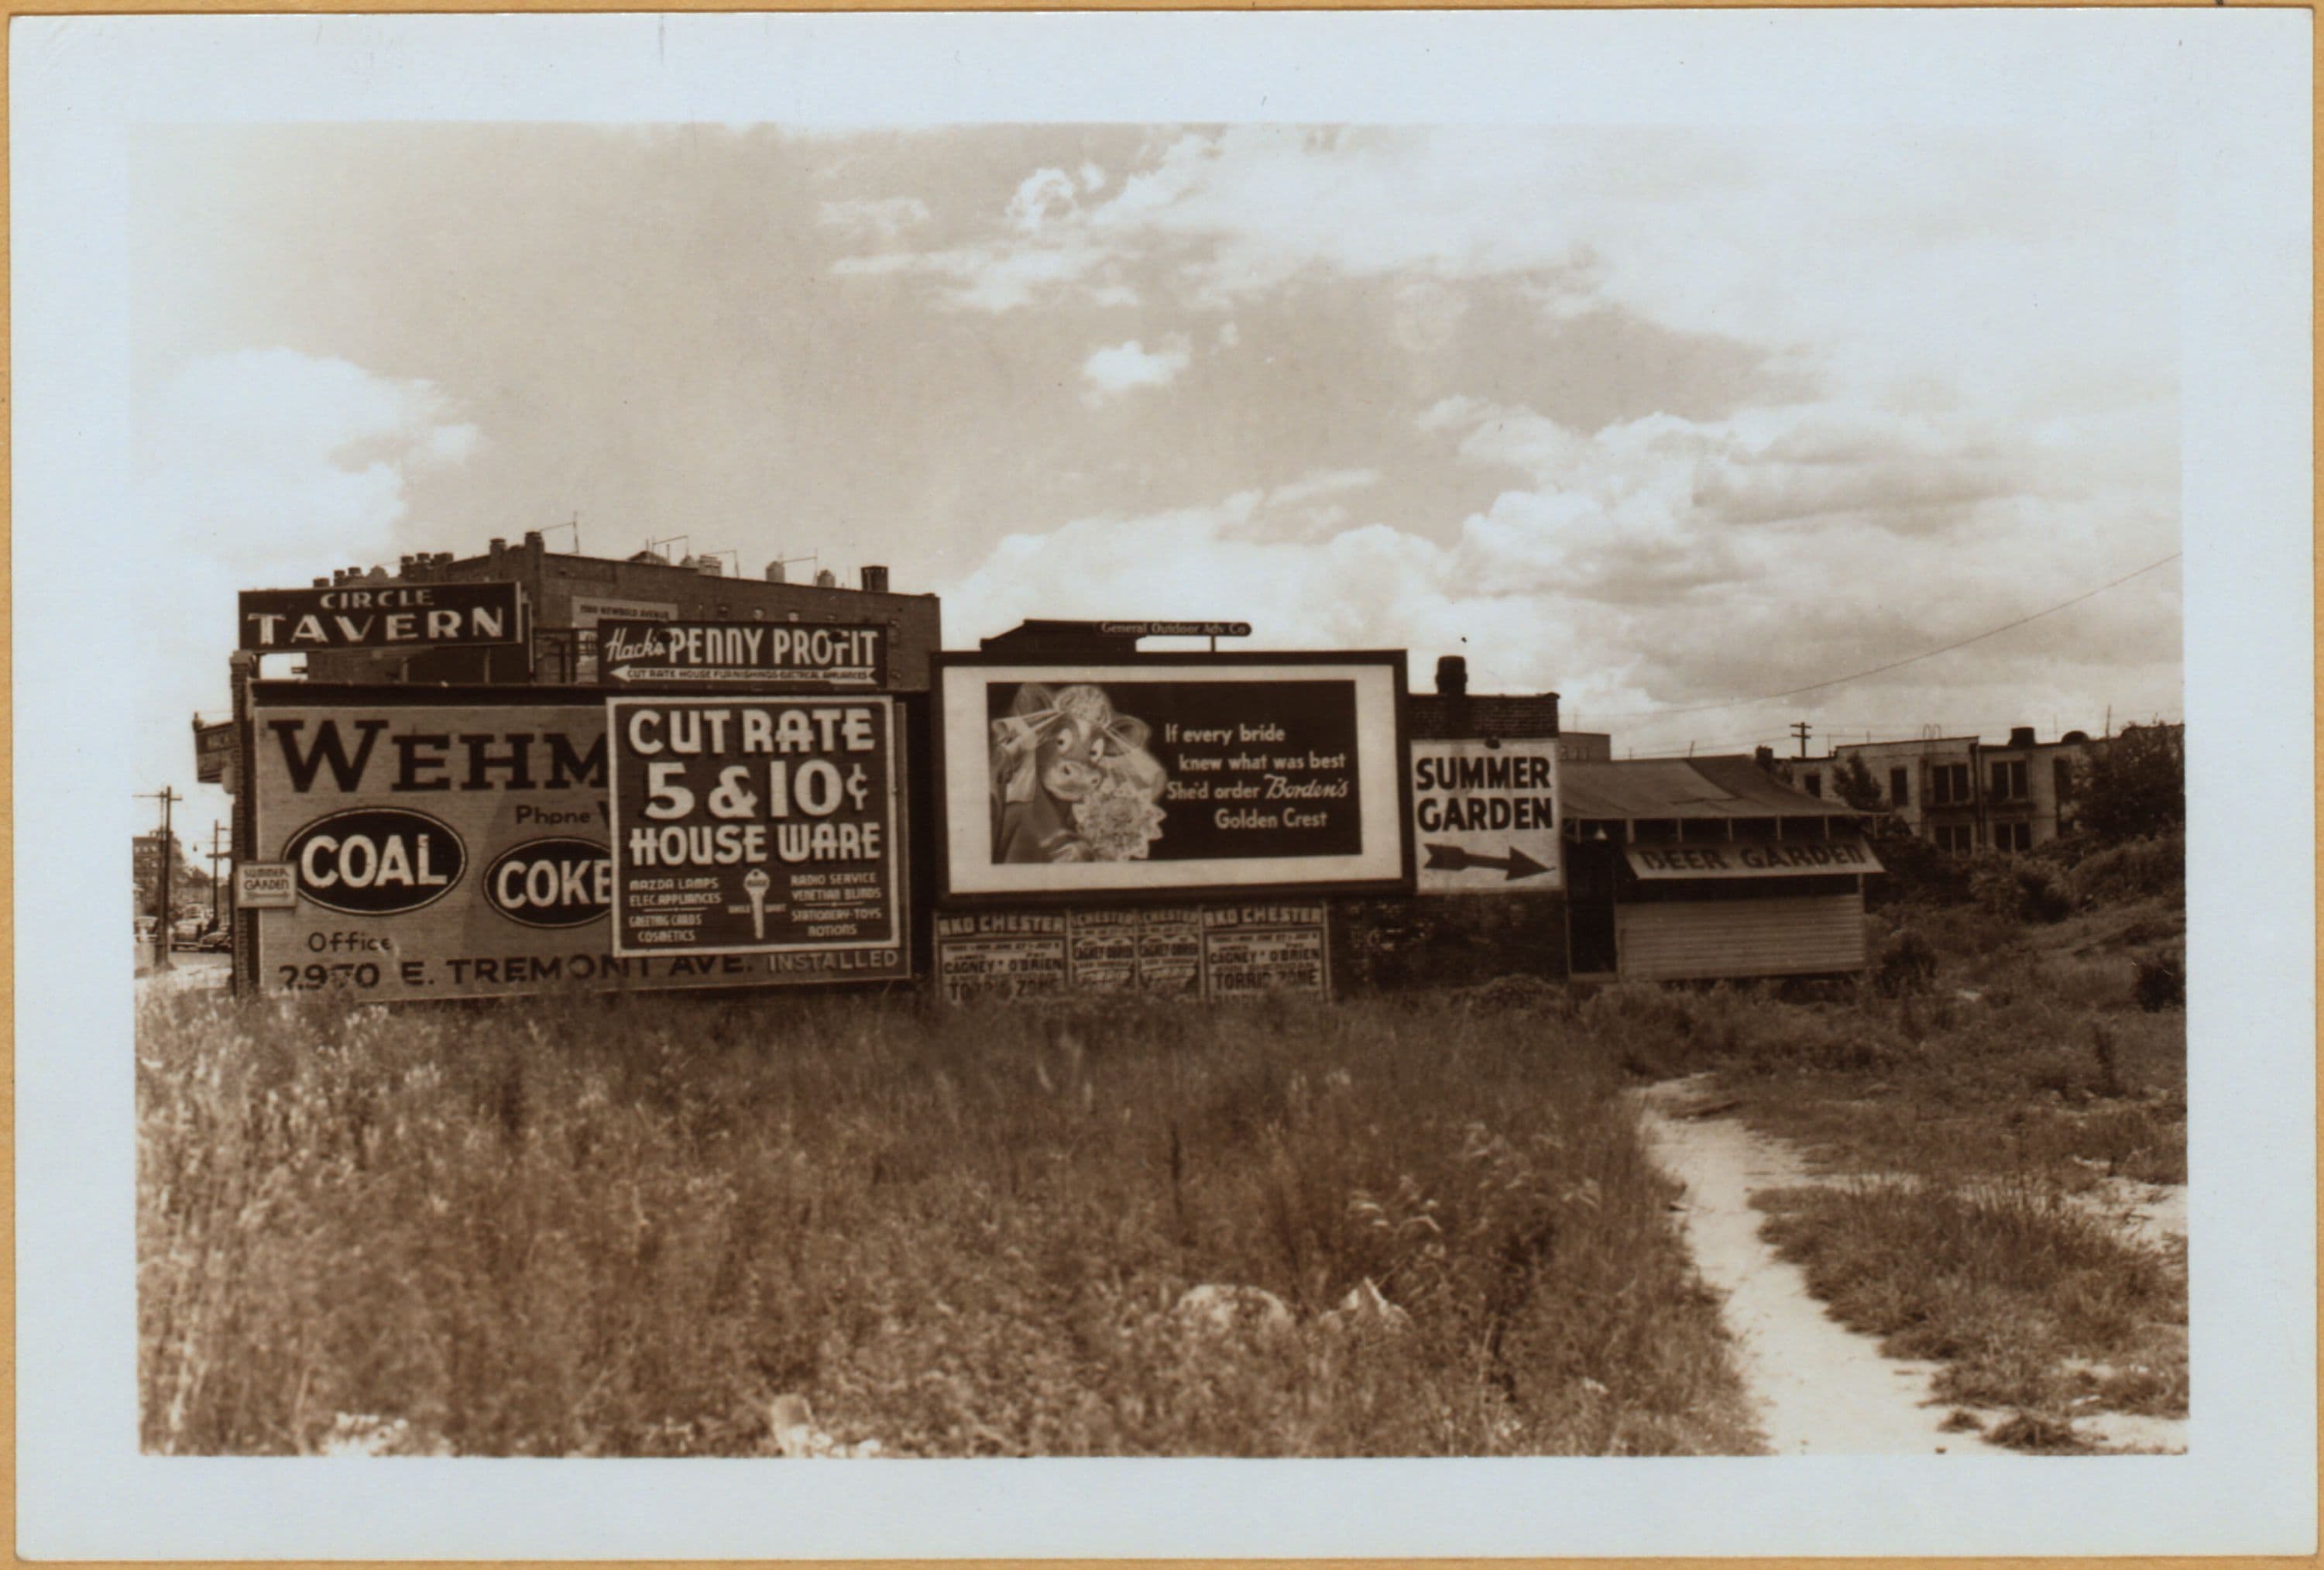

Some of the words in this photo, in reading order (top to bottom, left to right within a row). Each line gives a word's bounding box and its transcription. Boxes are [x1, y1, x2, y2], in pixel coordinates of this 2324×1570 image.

[320, 589, 434, 609] CIRCLE
[248, 606, 503, 645] TAVERN
[1101, 622, 1147, 634] General
[1151, 622, 1200, 634] Outdoor
[668, 627, 765, 665] PENNY
[774, 629, 879, 667] PROFIT
[627, 668, 646, 679] CUT
[649, 668, 675, 679] RATE
[678, 668, 711, 679] HOUSE
[629, 709, 731, 755] CUT
[742, 708, 875, 754] RATE
[1165, 723, 1179, 743] If
[1183, 728, 1233, 746] every
[1240, 723, 1286, 743] bride
[1179, 754, 1223, 771] knew
[1228, 751, 1268, 770] what
[1273, 755, 1306, 769] was
[1309, 751, 1347, 768] best
[1416, 756, 1551, 792] SUMMER
[644, 761, 696, 820] 5
[708, 764, 758, 819] &
[1167, 780, 1210, 801] She'd
[1214, 780, 1261, 799] order
[1262, 774, 1348, 799] Borden's
[516, 804, 591, 826] Phone
[1214, 807, 1278, 830] Golden
[1282, 806, 1327, 828] Crest
[1416, 797, 1553, 833] GARDEN
[629, 824, 768, 867] HOUSE
[777, 822, 881, 864] WARE
[300, 833, 448, 888] COAL
[1740, 843, 1867, 870] GARDEN
[244, 878, 290, 891] GARDEN
[497, 859, 612, 909] COKE
[629, 878, 674, 891] MAZDA
[678, 877, 719, 889] LAMPS
[790, 874, 826, 886] RADIO
[829, 872, 877, 885] SERVICE
[791, 888, 841, 901] VENETIAN
[843, 887, 882, 900] BLINDS
[979, 915, 1066, 933] CHESTER
[1241, 906, 1323, 923] CHESTER
[637, 929, 696, 943] COSMETICS
[807, 923, 857, 937] NOTIONS
[308, 931, 393, 953] Office
[400, 960, 434, 986] E.
[446, 953, 650, 986] TREMONT
[768, 949, 899, 974] INSTALLED
[944, 960, 994, 975] CAGNEY
[1210, 951, 1257, 965] CAGNEY
